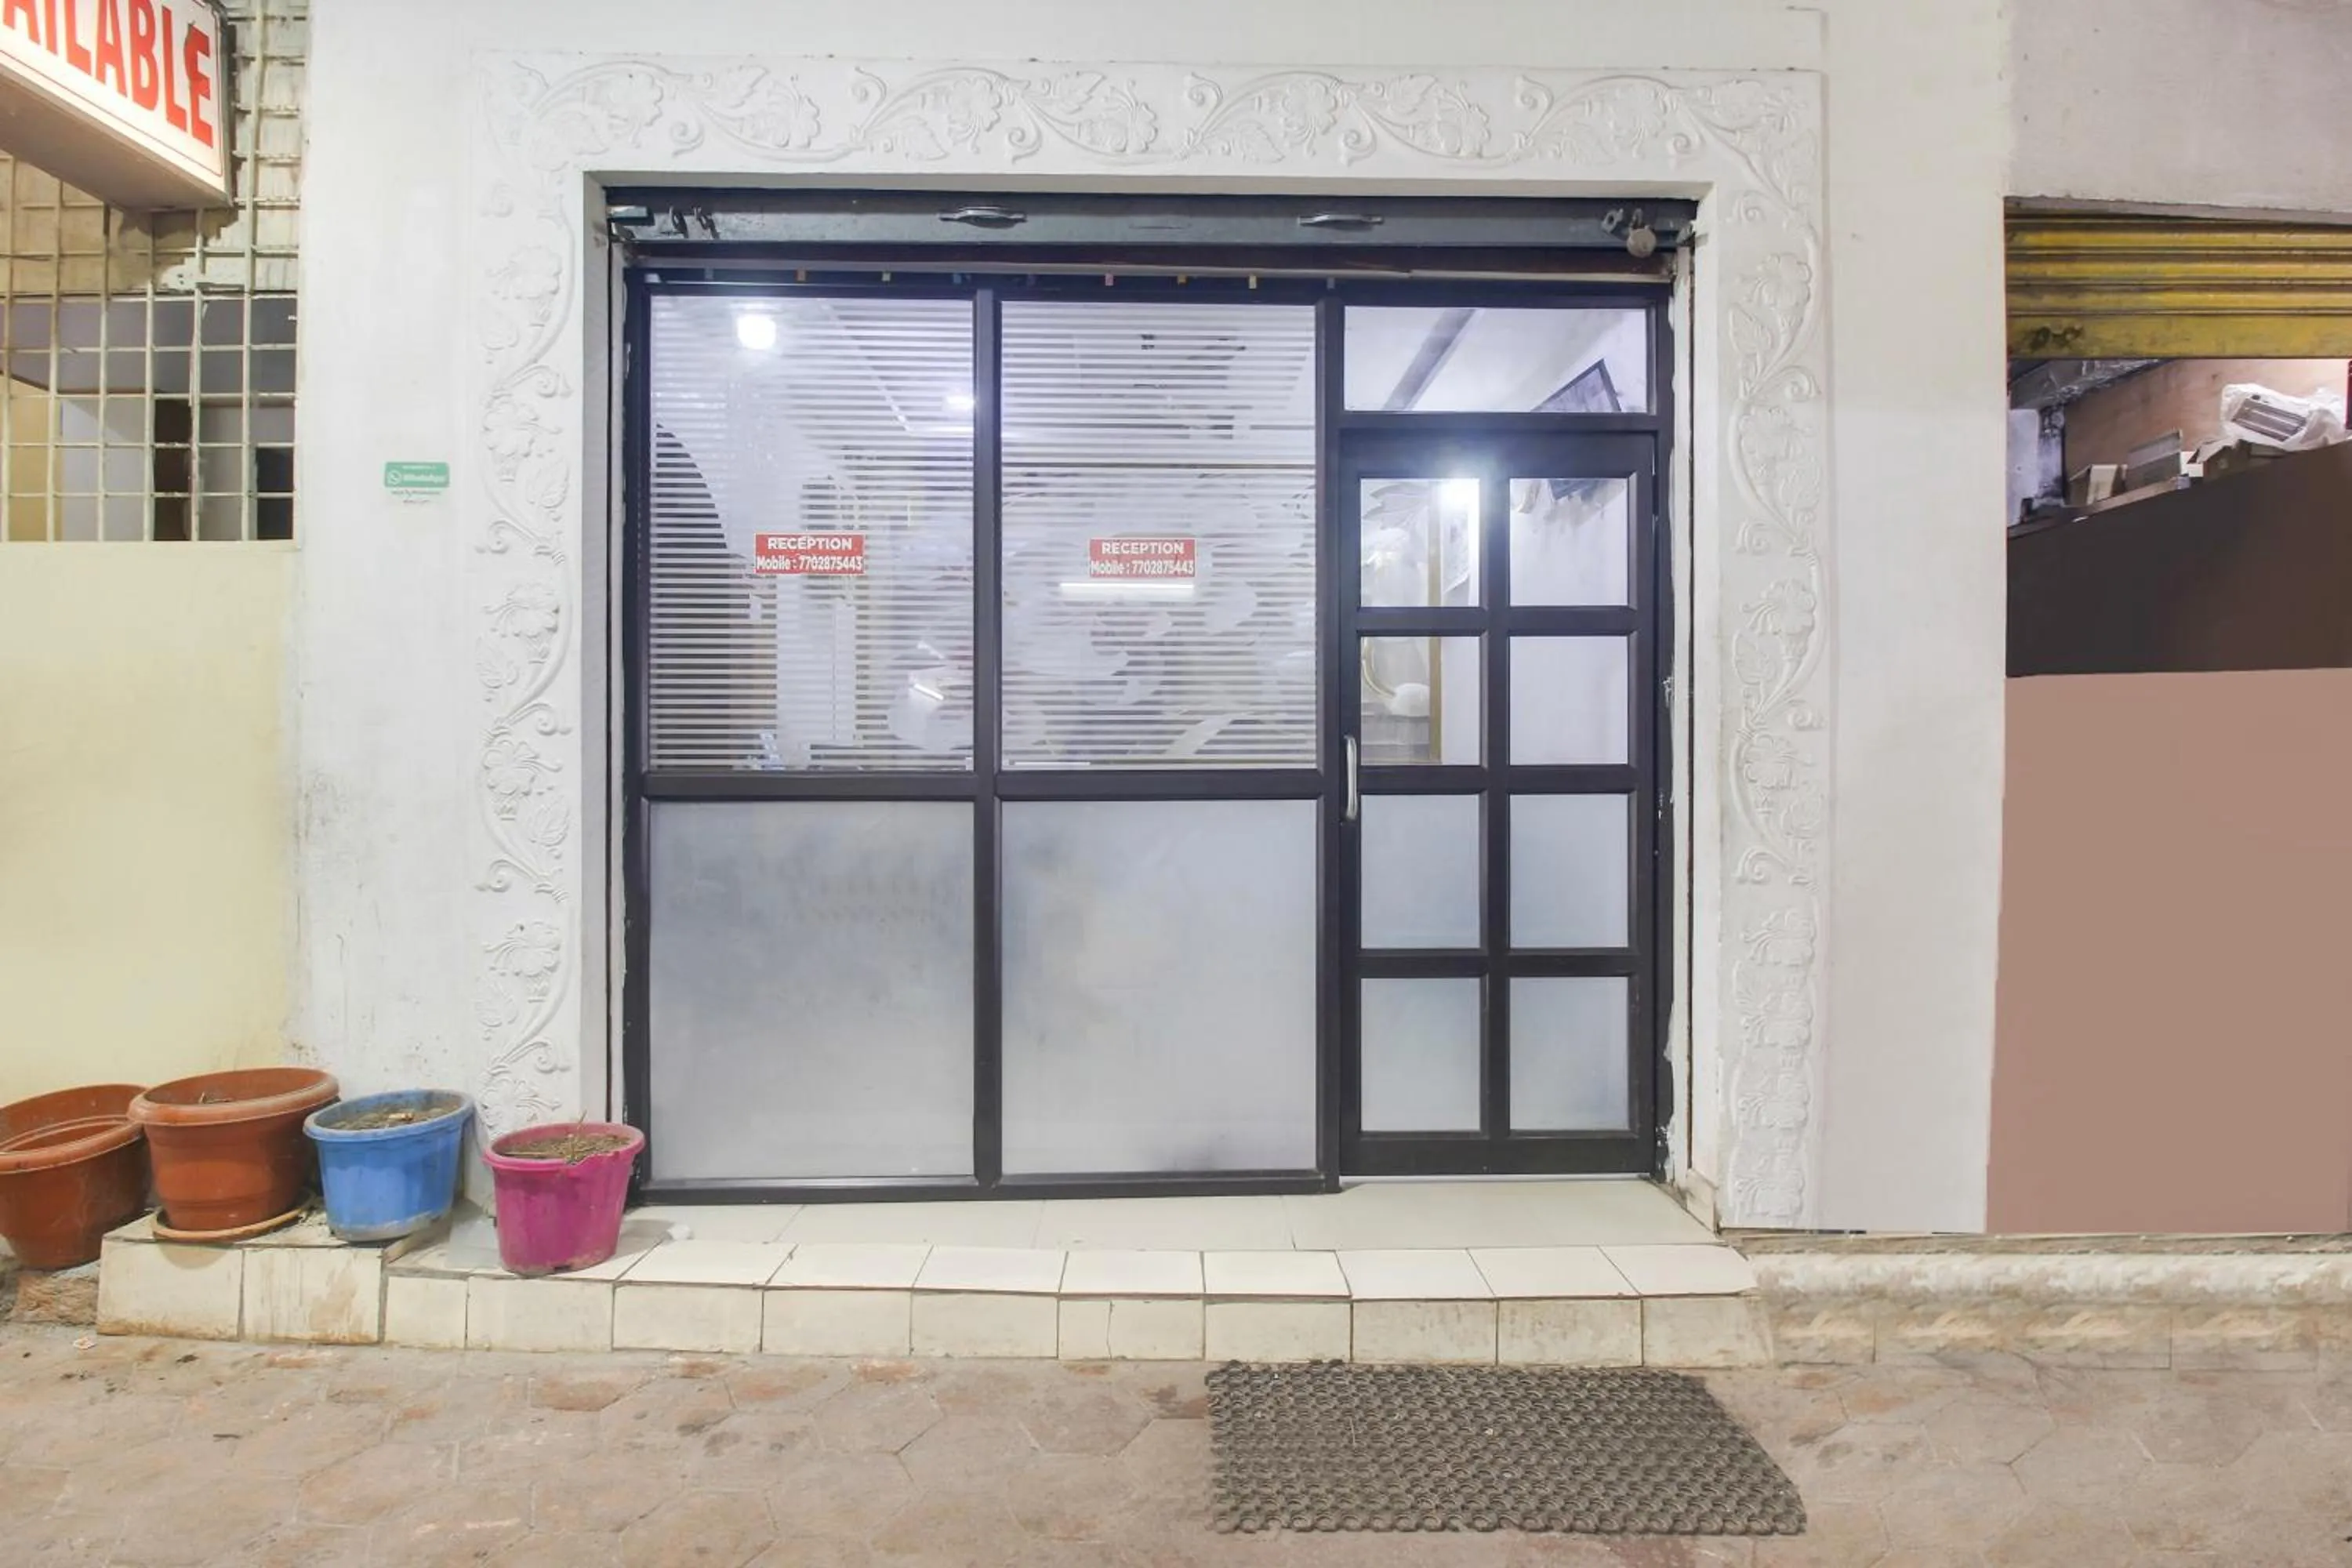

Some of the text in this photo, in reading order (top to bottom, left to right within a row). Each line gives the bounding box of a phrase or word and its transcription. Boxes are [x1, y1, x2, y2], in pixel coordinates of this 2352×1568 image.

[768, 537, 853, 550] RECEPTION
[1102, 542, 1185, 554] RECEPTION
[799, 556, 862, 570] 7702875443
[1131, 560, 1193, 575] 7702875443
